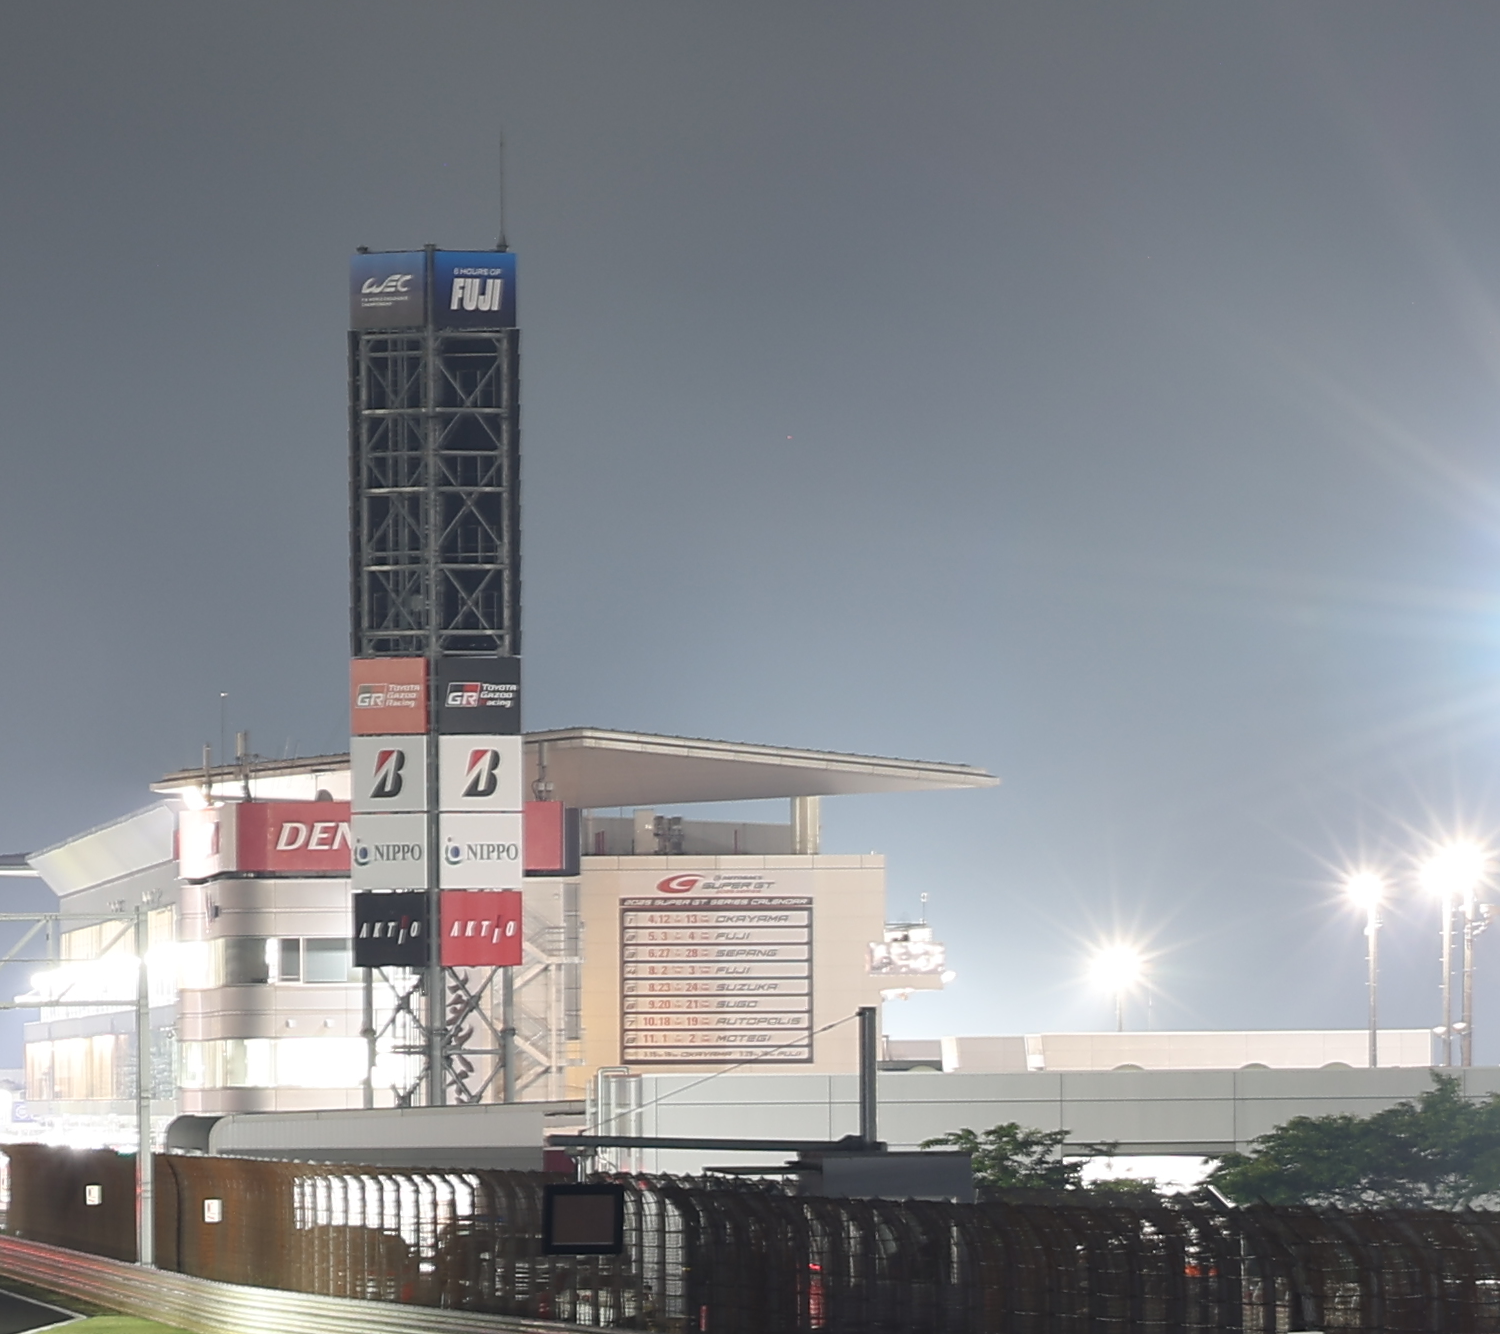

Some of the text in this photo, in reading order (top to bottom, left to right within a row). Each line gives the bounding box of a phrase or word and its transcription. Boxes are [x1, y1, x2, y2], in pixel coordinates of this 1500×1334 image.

[361, 273, 414, 295] WEC
[450, 277, 503, 311] FUJI
[482, 683, 518, 691] TOYOTA
[357, 693, 384, 707] GR
[386, 699, 416, 708] Racing
[447, 692, 478, 706] GR
[374, 843, 422, 861] NIPPO
[466, 843, 518, 861] NIPPO
[702, 881, 776, 889] SUPER GT
[714, 915, 790, 923] OKAYAMA
[359, 917, 421, 945] AKTIO
[450, 915, 516, 944] AKTIO
[714, 932, 750, 940] FUJI
[714, 949, 778, 957] SEPANG
[714, 967, 750, 975] FUJI
[714, 983, 779, 991] SUZUKA
[714, 1000, 758, 1009] SUGO
[714, 1017, 802, 1025] AUTOPOLIS
[715, 1035, 772, 1043] MOTEGI
